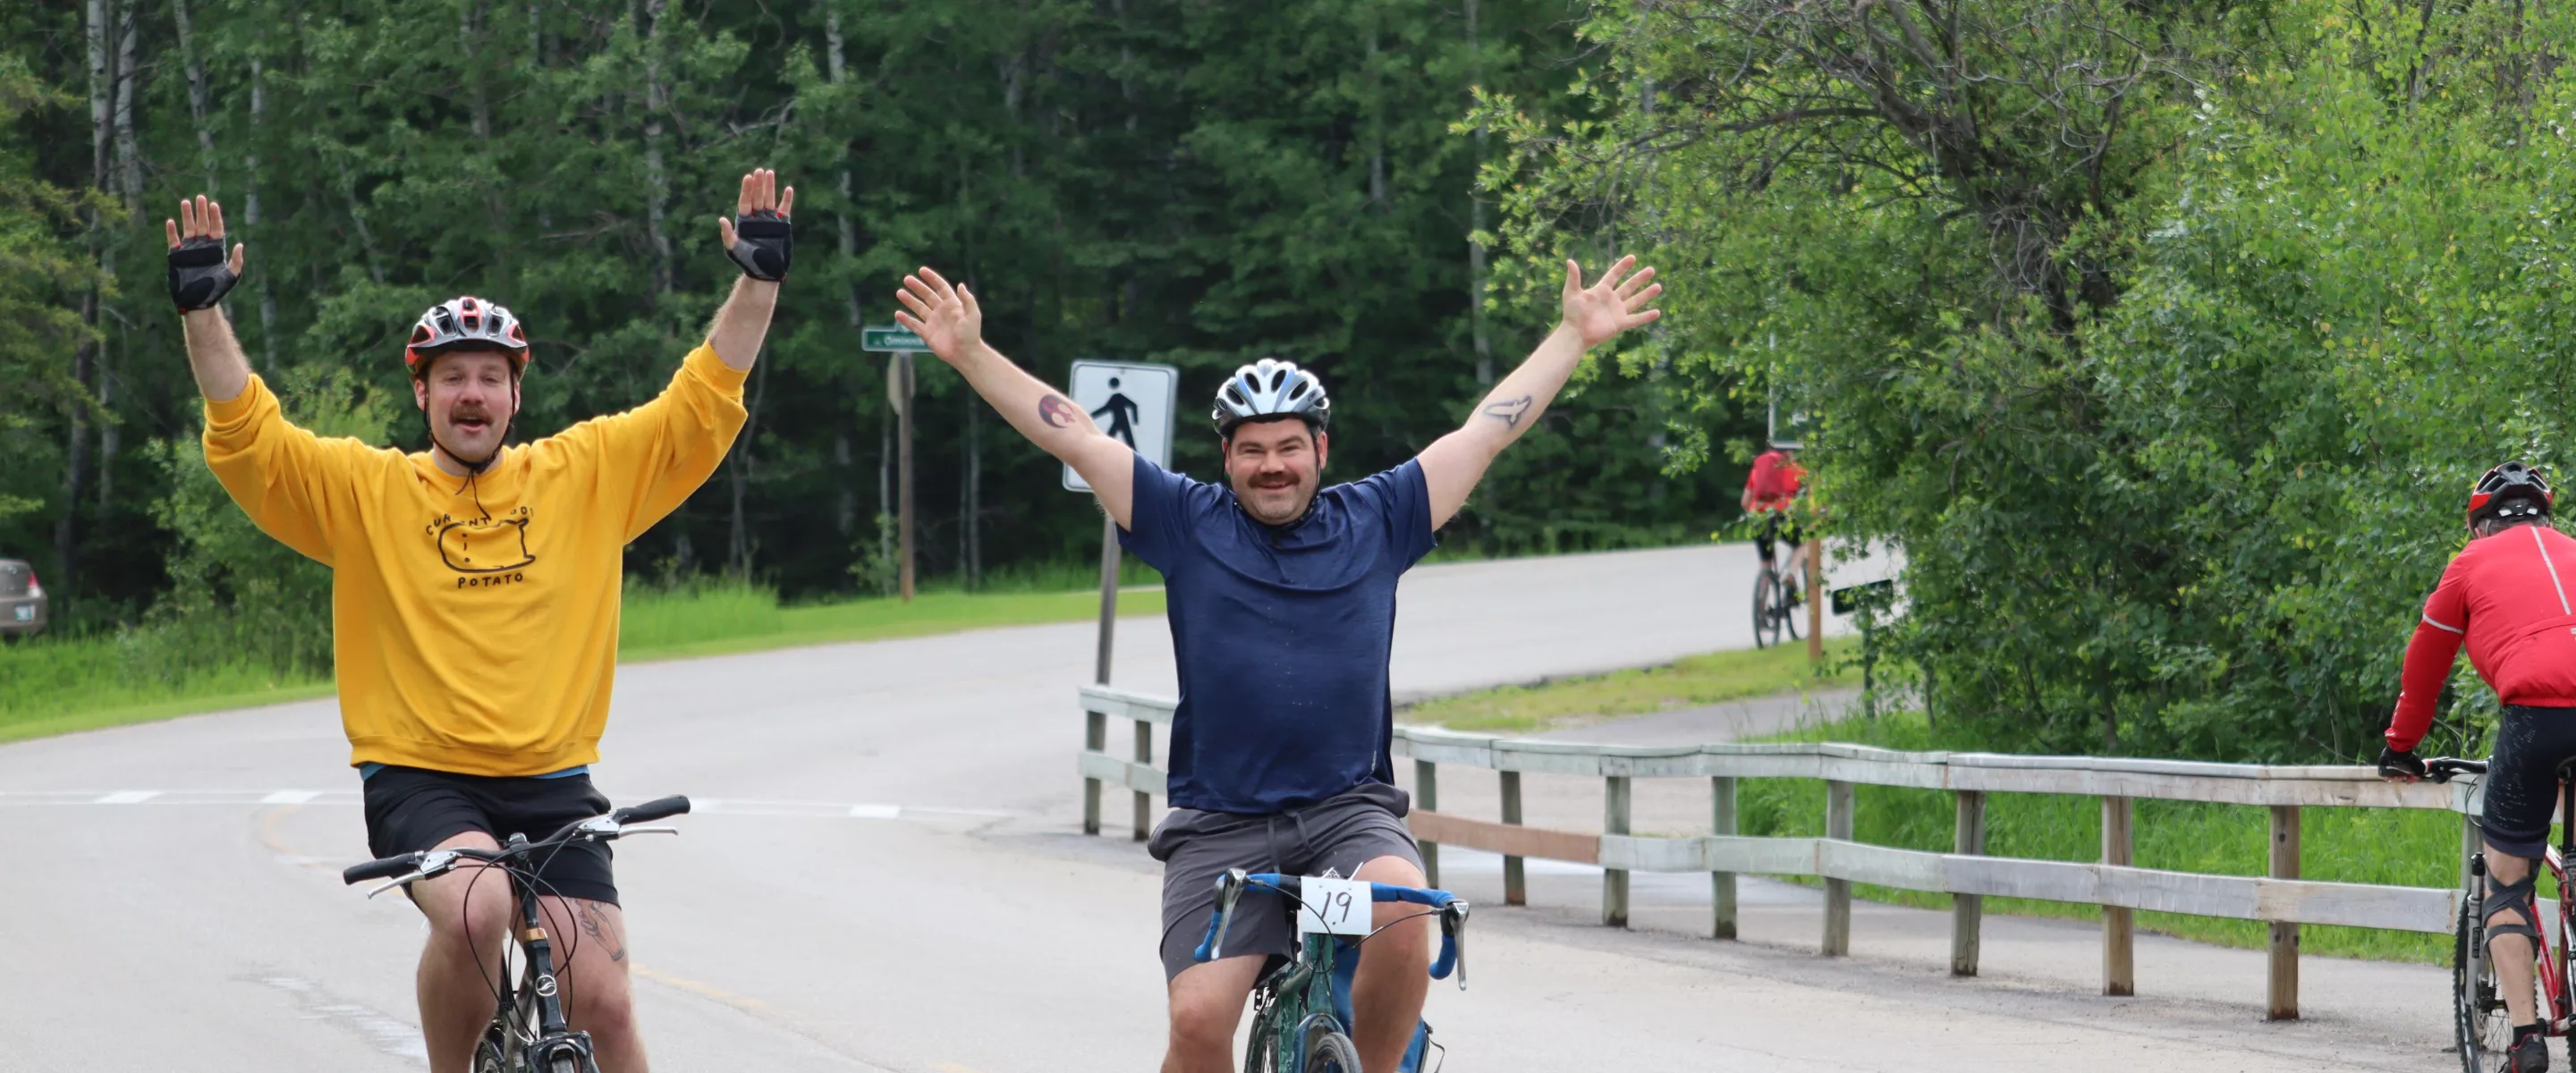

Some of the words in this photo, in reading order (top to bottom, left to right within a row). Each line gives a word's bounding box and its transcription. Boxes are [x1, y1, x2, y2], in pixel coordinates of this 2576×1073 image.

[426, 514, 490, 536] CURNT
[457, 572, 523, 588] POTATO
[1320, 891, 1352, 924] 19
